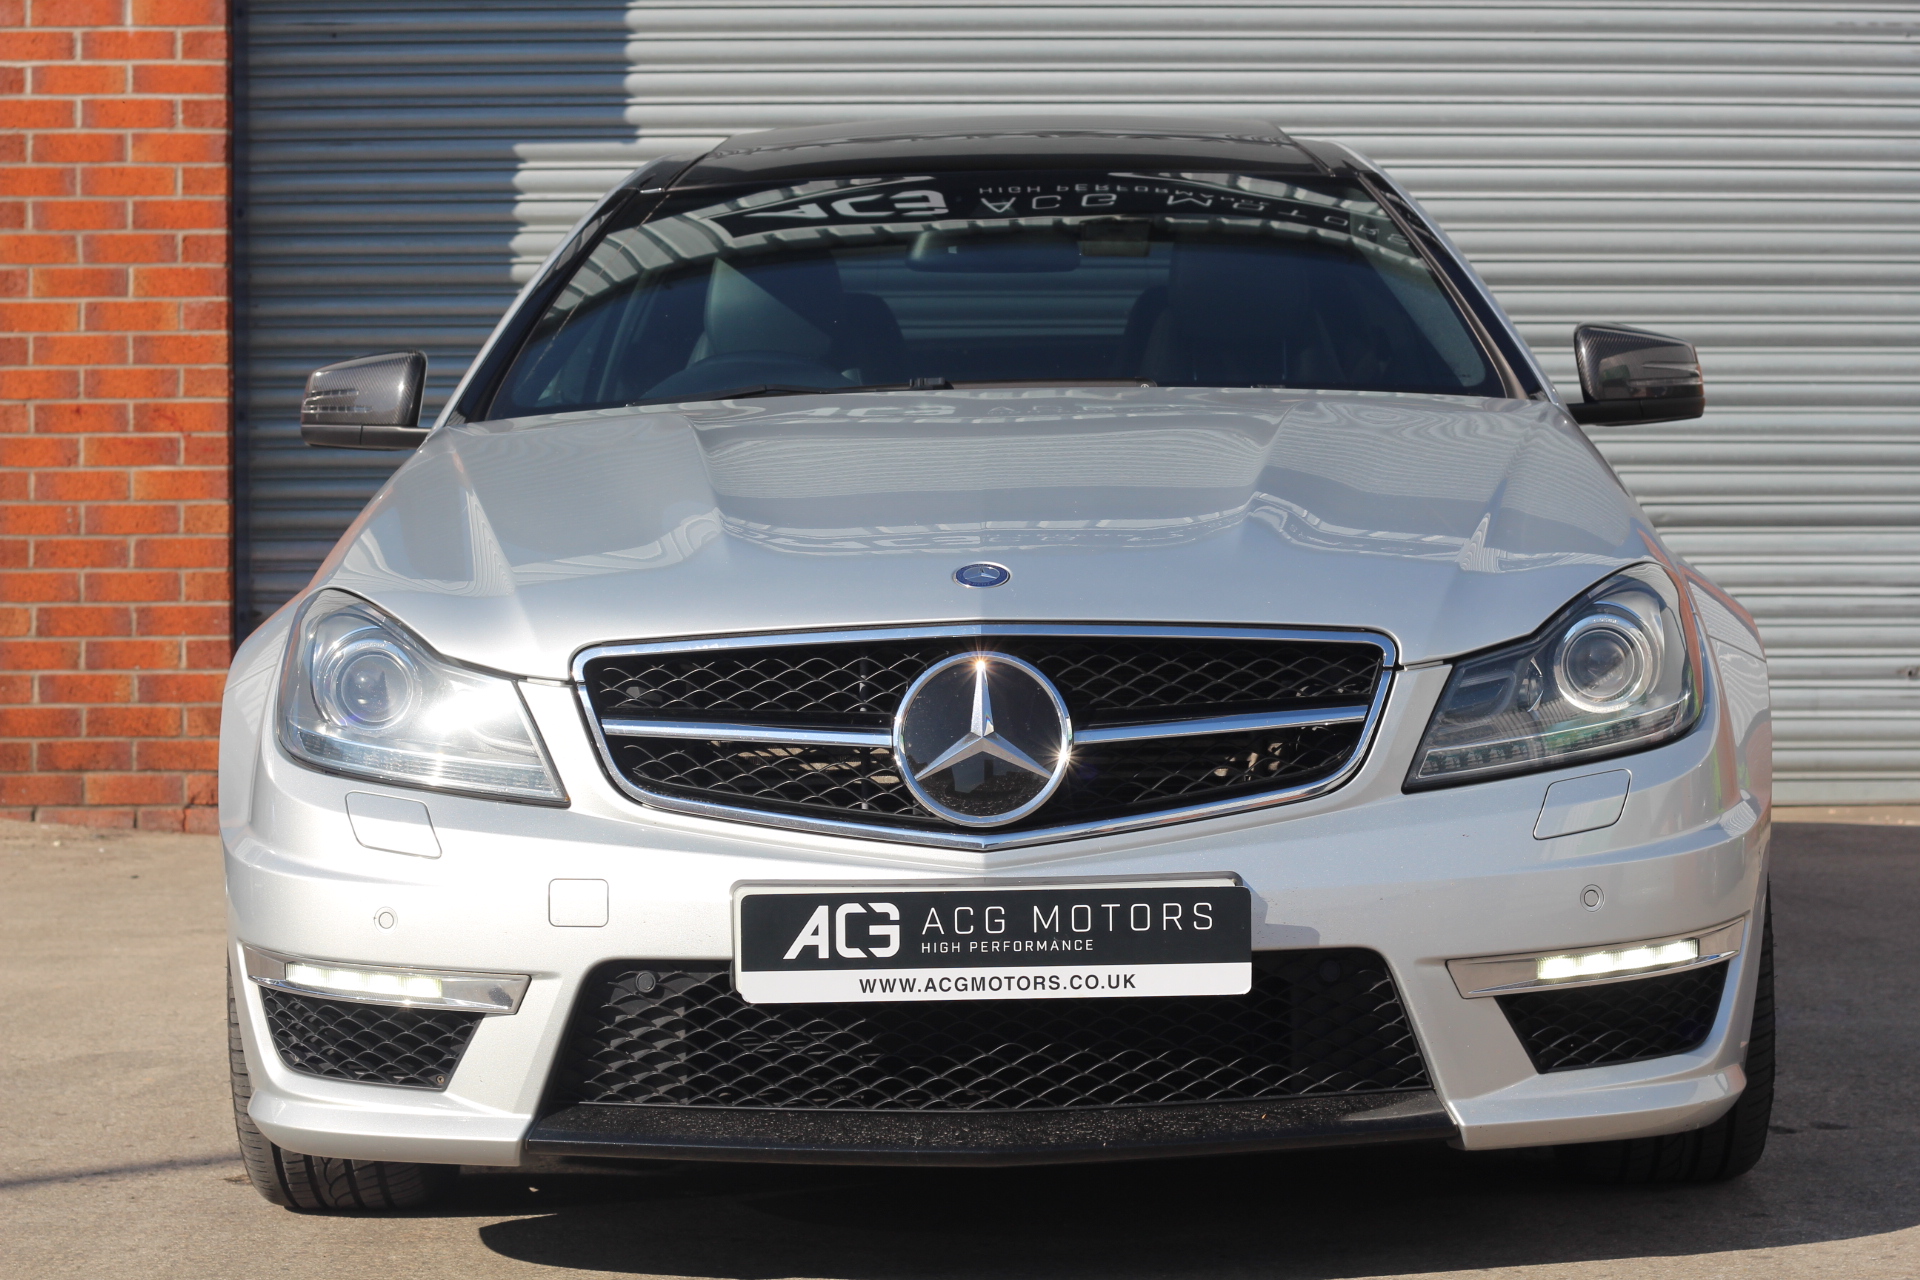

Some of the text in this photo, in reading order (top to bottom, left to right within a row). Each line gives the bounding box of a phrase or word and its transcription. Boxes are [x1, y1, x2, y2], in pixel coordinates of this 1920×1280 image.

[783, 902, 900, 959] ACG
[921, 902, 1213, 935] ACG MOTORS
[921, 939, 1094, 953] HIGH PERFORMANCE
[859, 973, 1137, 993] WWW.ACGMOTORS.CO.UK
